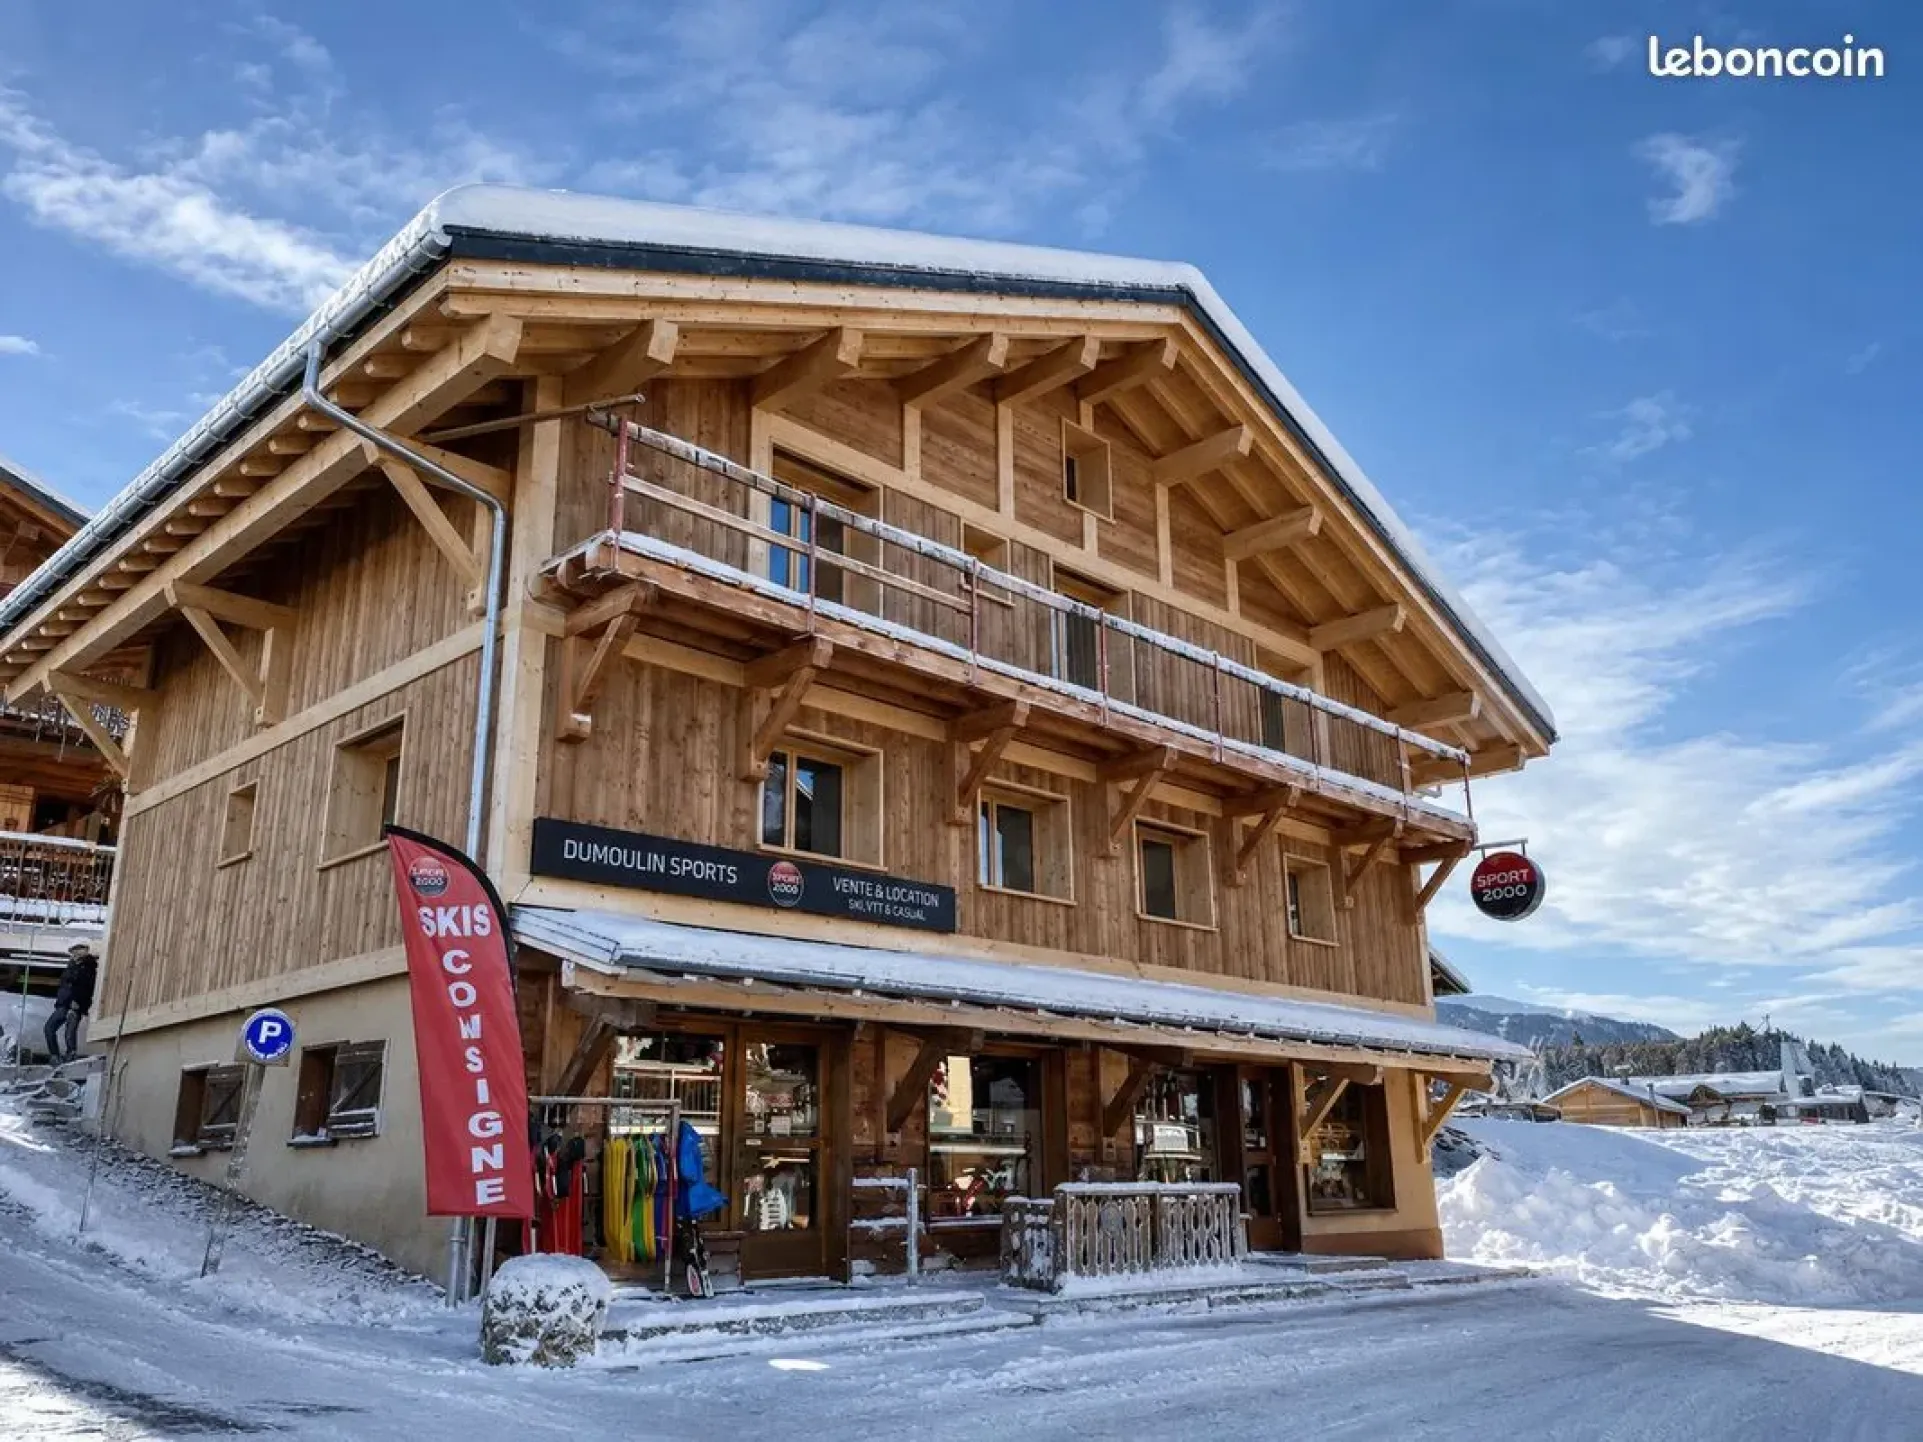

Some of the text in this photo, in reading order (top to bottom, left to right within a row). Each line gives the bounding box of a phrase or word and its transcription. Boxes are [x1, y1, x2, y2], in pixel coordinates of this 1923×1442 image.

[563, 839, 738, 884] DUMOULIN SPORTS
[773, 883, 799, 895] 2000
[832, 876, 939, 908] VENTE & LOCATION
[1477, 868, 1529, 888] SPORT
[1482, 884, 1528, 902] 2000
[418, 903, 491, 937] SKIS
[258, 1020, 282, 1044] P
[442, 949, 507, 1206] CONSIGNE
